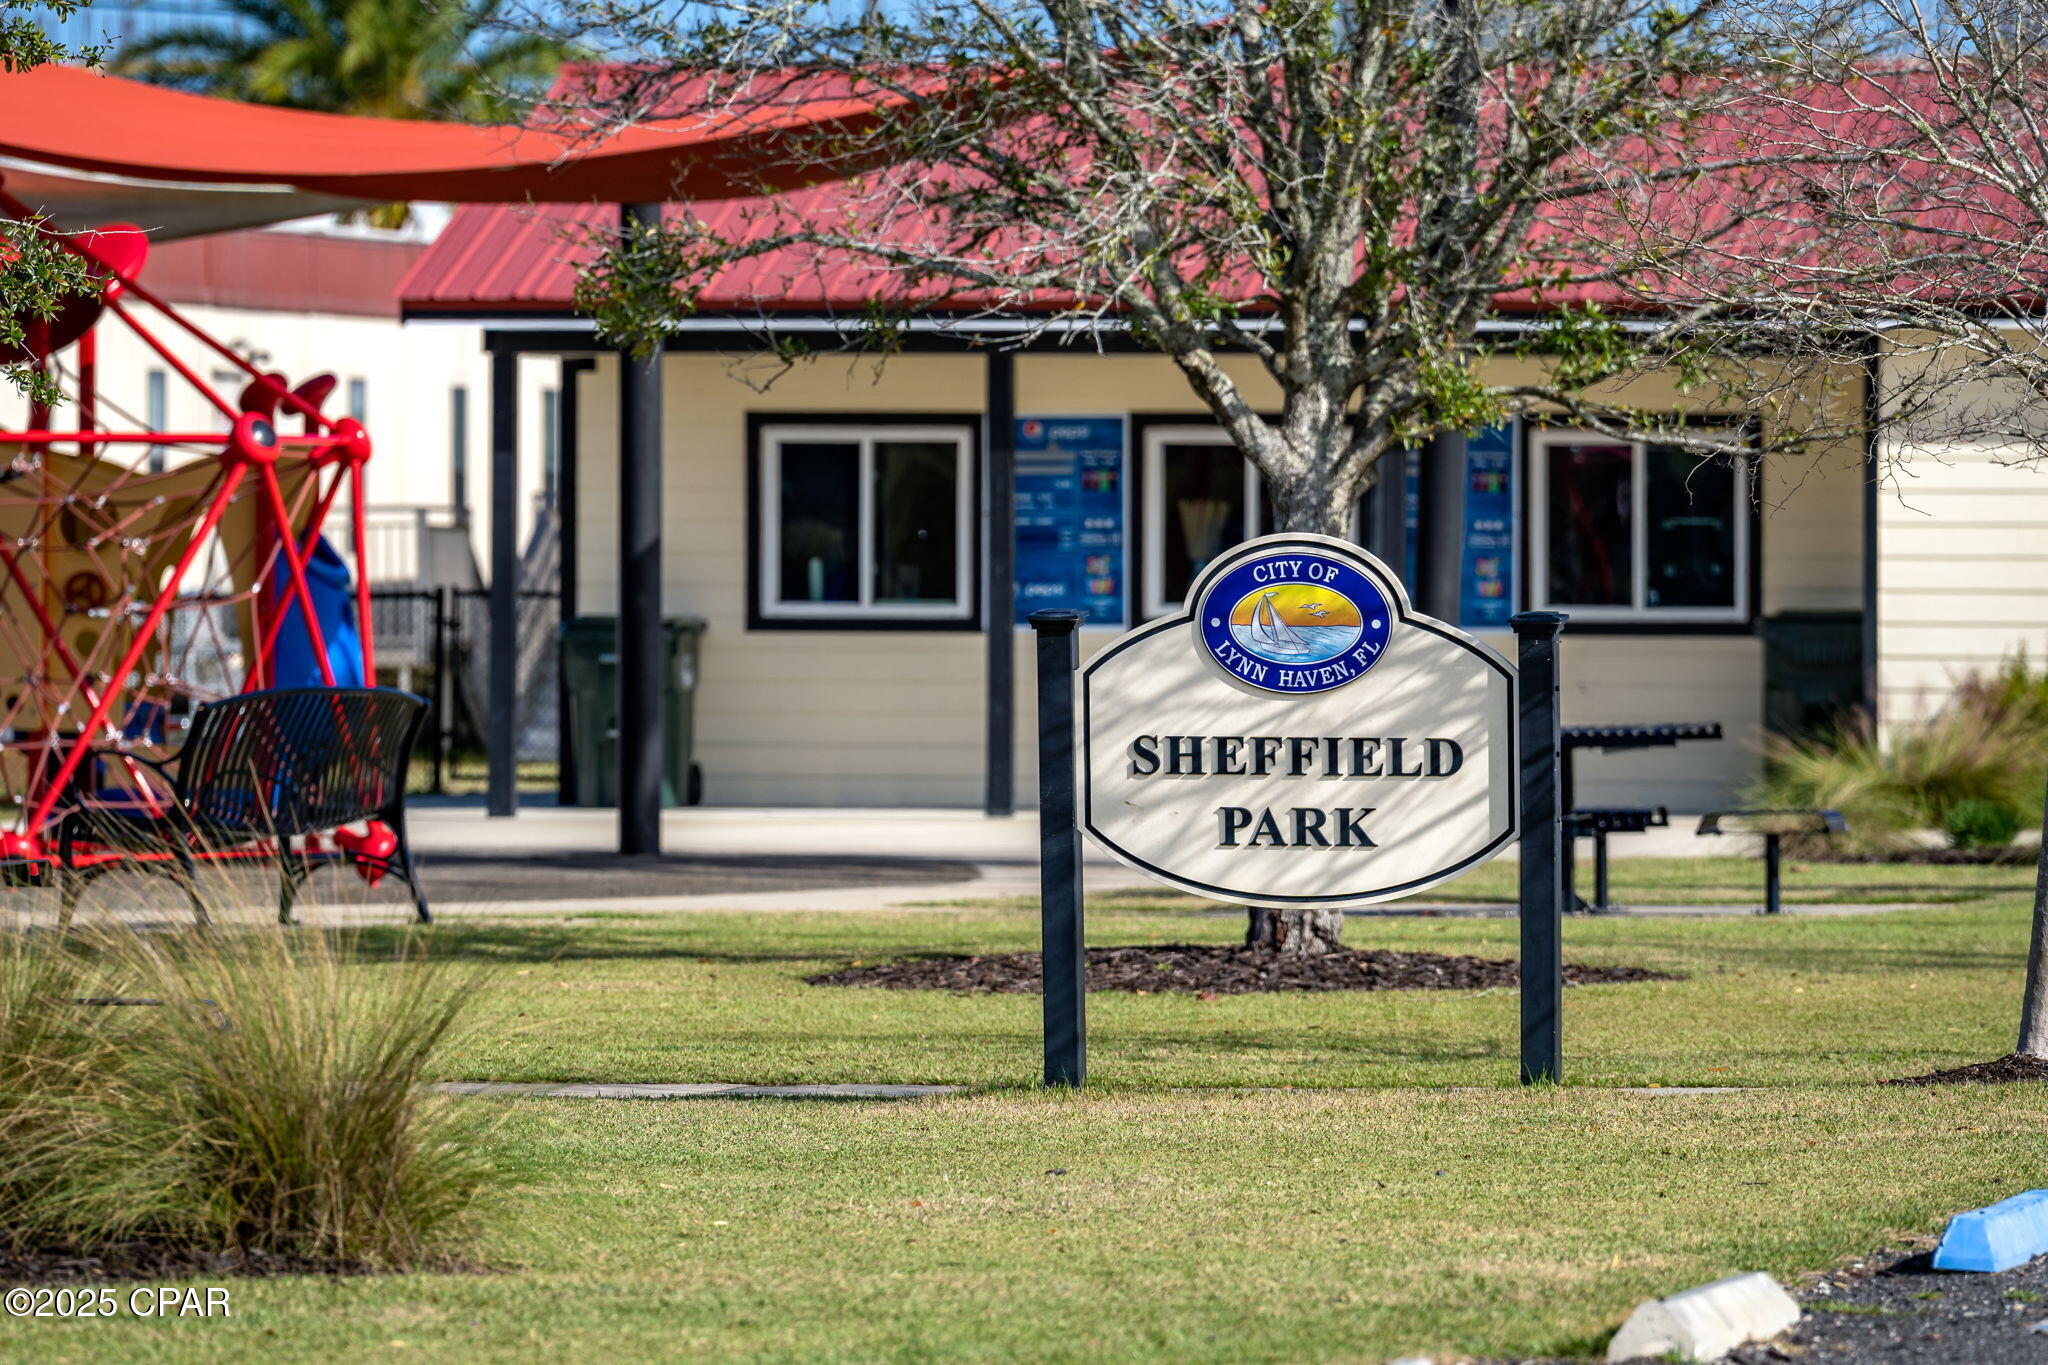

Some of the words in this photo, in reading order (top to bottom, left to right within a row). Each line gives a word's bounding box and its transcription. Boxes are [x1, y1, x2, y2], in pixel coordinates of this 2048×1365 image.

[1253, 561, 1303, 583] CITY
[1308, 562, 1339, 583] OF
[1214, 640, 1269, 682] LYNN
[1278, 662, 1356, 687] HAVEN,
[1352, 641, 1381, 667] FL
[1130, 734, 1464, 779] SHEFFIELD
[1216, 806, 1379, 849] PARK
